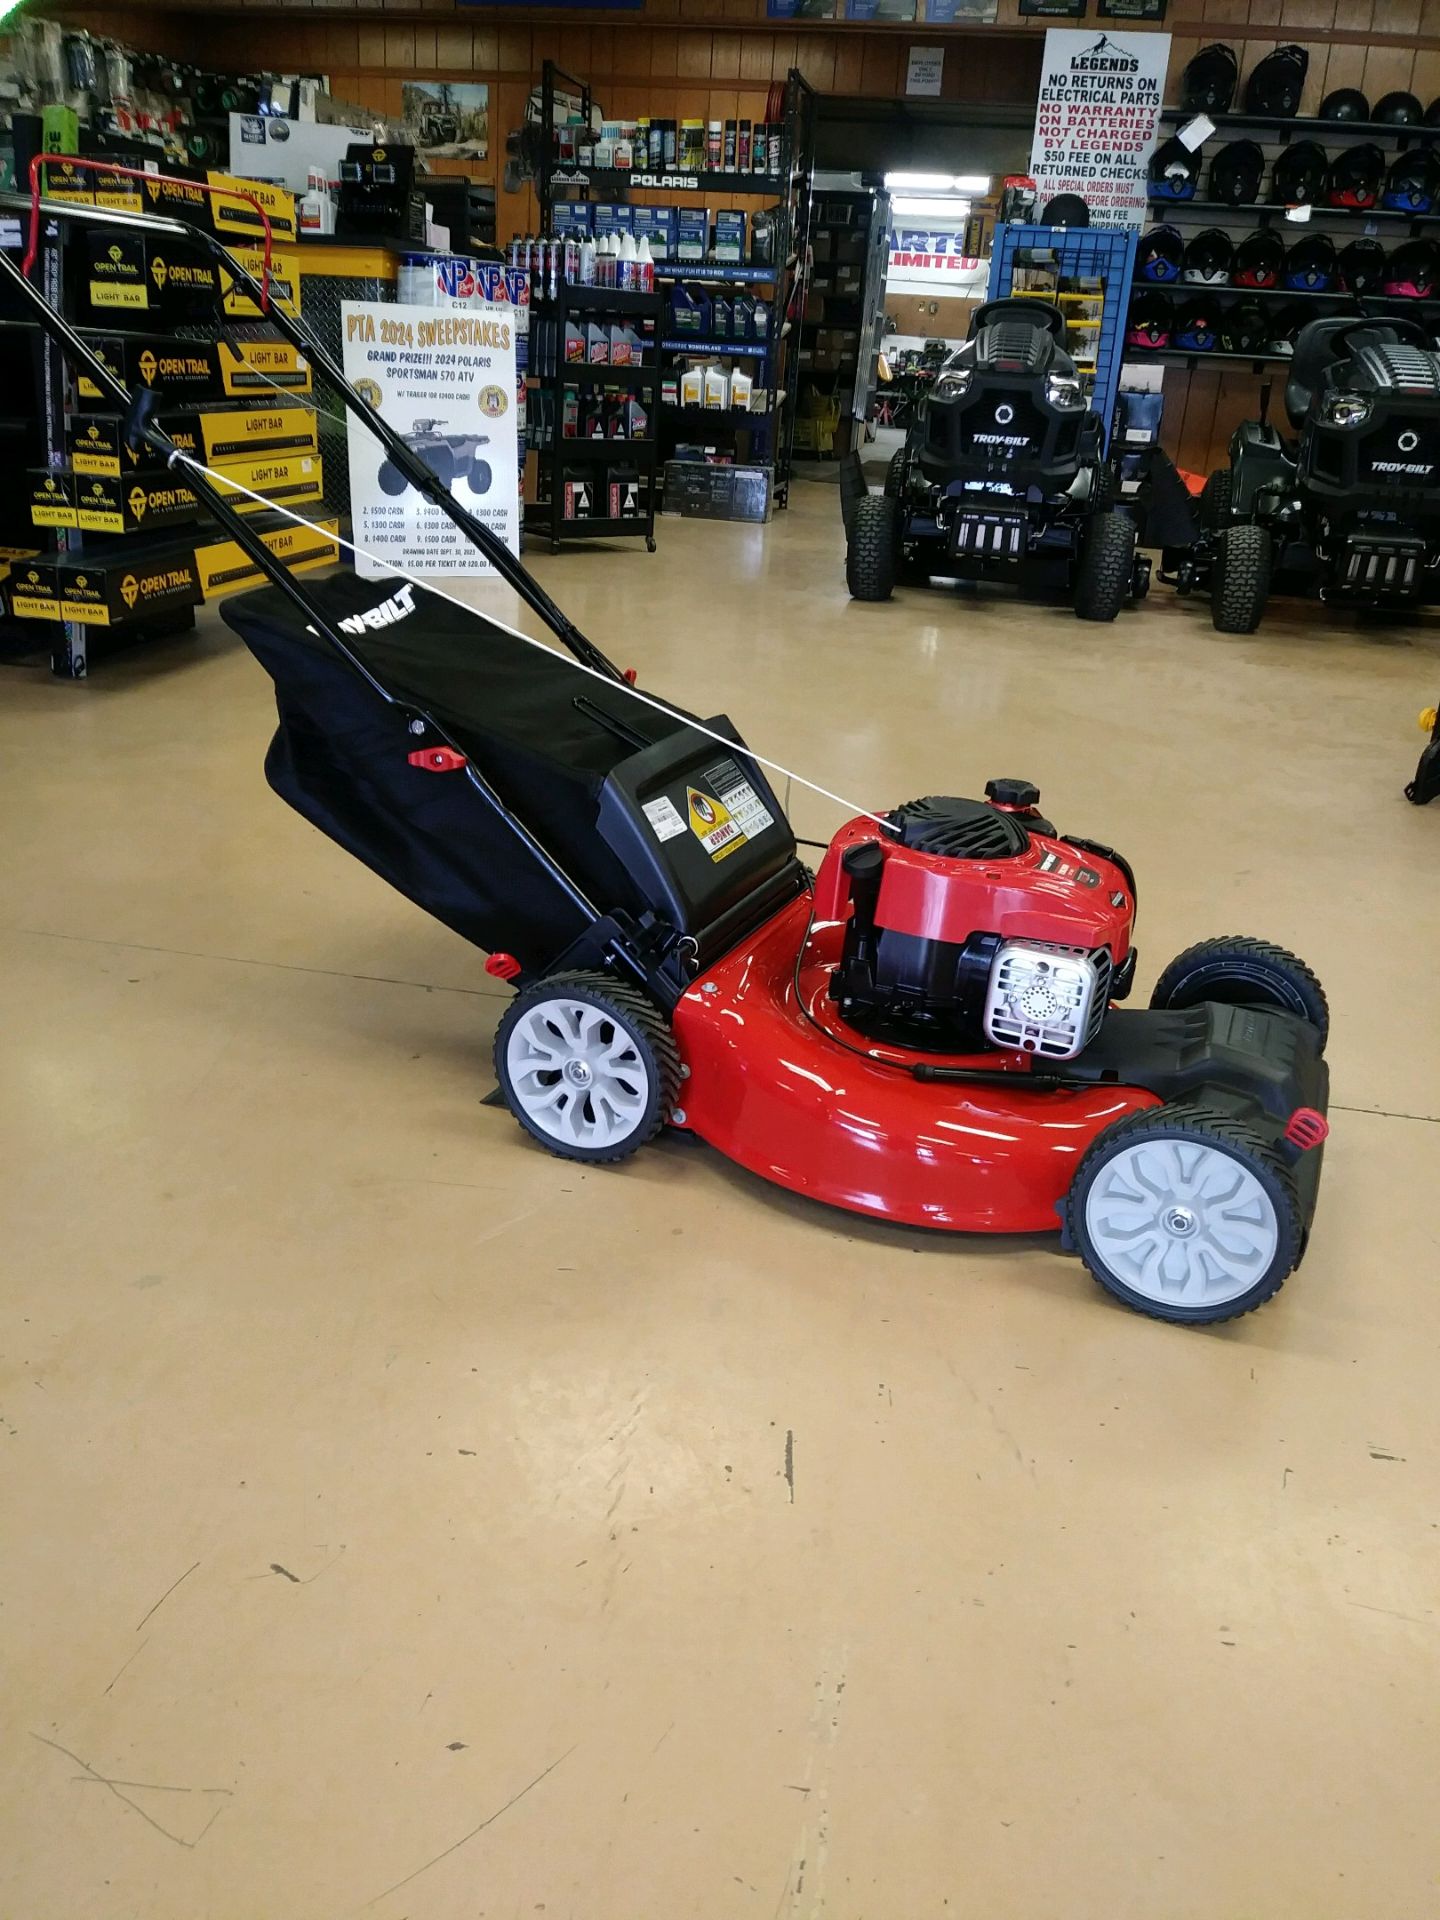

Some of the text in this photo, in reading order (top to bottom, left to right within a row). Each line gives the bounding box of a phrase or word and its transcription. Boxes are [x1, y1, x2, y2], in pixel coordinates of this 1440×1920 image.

[1070, 56, 1139, 72] LEGENDS
[1049, 74, 1157, 91] NO RETURNS ON
[1041, 88, 1160, 106] ELECTRICAL PARTS
[1040, 104, 1159, 118] NO WARRANTY
[1039, 116, 1154, 129] ON BATTERIES
[1038, 127, 1152, 141] NOT CHARGED
[1044, 138, 1144, 152] BY LEGENDS
[1044, 150, 1137, 166] $50 FEE ON ALL
[1032, 164, 1148, 180] RETURNED CHECKS
[50, 176, 86, 184] OPEN TRAIL
[98, 176, 134, 186] OPEN TRAIL
[630, 174, 698, 188] POLARIS
[1044, 179, 1134, 194] ALL SPECIAL ORDERS MUST
[162, 182, 182, 198] OPEN
[184, 185, 204, 202] TRAIL
[260, 192, 276, 206] BAR
[97, 198, 138, 206] LIGHT BAR
[1084, 194, 1110, 206] BEFORE
[1110, 196, 1145, 208] ORDERING
[1114, 210, 1128, 220] FEE
[890, 230, 964, 254] ARTS
[94, 262, 138, 274] OPEN TRAIL
[889, 252, 978, 270] IMITED
[169, 266, 214, 284] OPEN TRAIL
[124, 294, 140, 302] BAR
[347, 314, 510, 350] PTA 2024 SWEEPSTAKES
[250, 352, 288, 364] LIGHT BAR
[367, 350, 492, 368] GRAND PRIZE!!! 2024 POLARIS
[160, 358, 210, 374] OPEN TRAIL
[386, 366, 474, 382] SPORTSMAN 570 ATV
[397, 390, 404, 398] W/
[406, 390, 427, 398] TRAILER
[246, 418, 282, 431] LIGHT BAR
[76, 439, 112, 450] OPEN TRAIL
[170, 433, 195, 448] TRAIL
[973, 434, 1030, 446] TROY-BILT
[75, 458, 116, 469] LIGHT BAR
[1371, 461, 1434, 474] TROY-BILT
[252, 466, 288, 481] LIGHT BAR
[51, 492, 68, 500] TRAIL
[81, 496, 116, 506] OPEN TRAIL
[149, 491, 175, 508] OPEN
[34, 510, 73, 520] LIGHT BAR
[362, 506, 368, 514] 2.
[371, 506, 386, 514] $500
[388, 507, 404, 515] CASH
[103, 516, 119, 524] BAR
[389, 521, 405, 529] CASH
[441, 522, 456, 530] CASH
[491, 522, 506, 530] CASH
[264, 535, 293, 550] GHT BAR
[364, 535, 370, 543] 8.
[372, 535, 388, 543] $400
[390, 535, 406, 543] CASH
[16, 583, 52, 593] OPEN TRAIL
[140, 575, 167, 594] OPEN
[167, 569, 192, 585] TRAIL
[64, 588, 100, 598] OPEN TRAIL
[16, 601, 55, 612] LIGHT BAR
[65, 606, 104, 616] LIGHT BAR
[708, 824, 734, 846] DANGER
